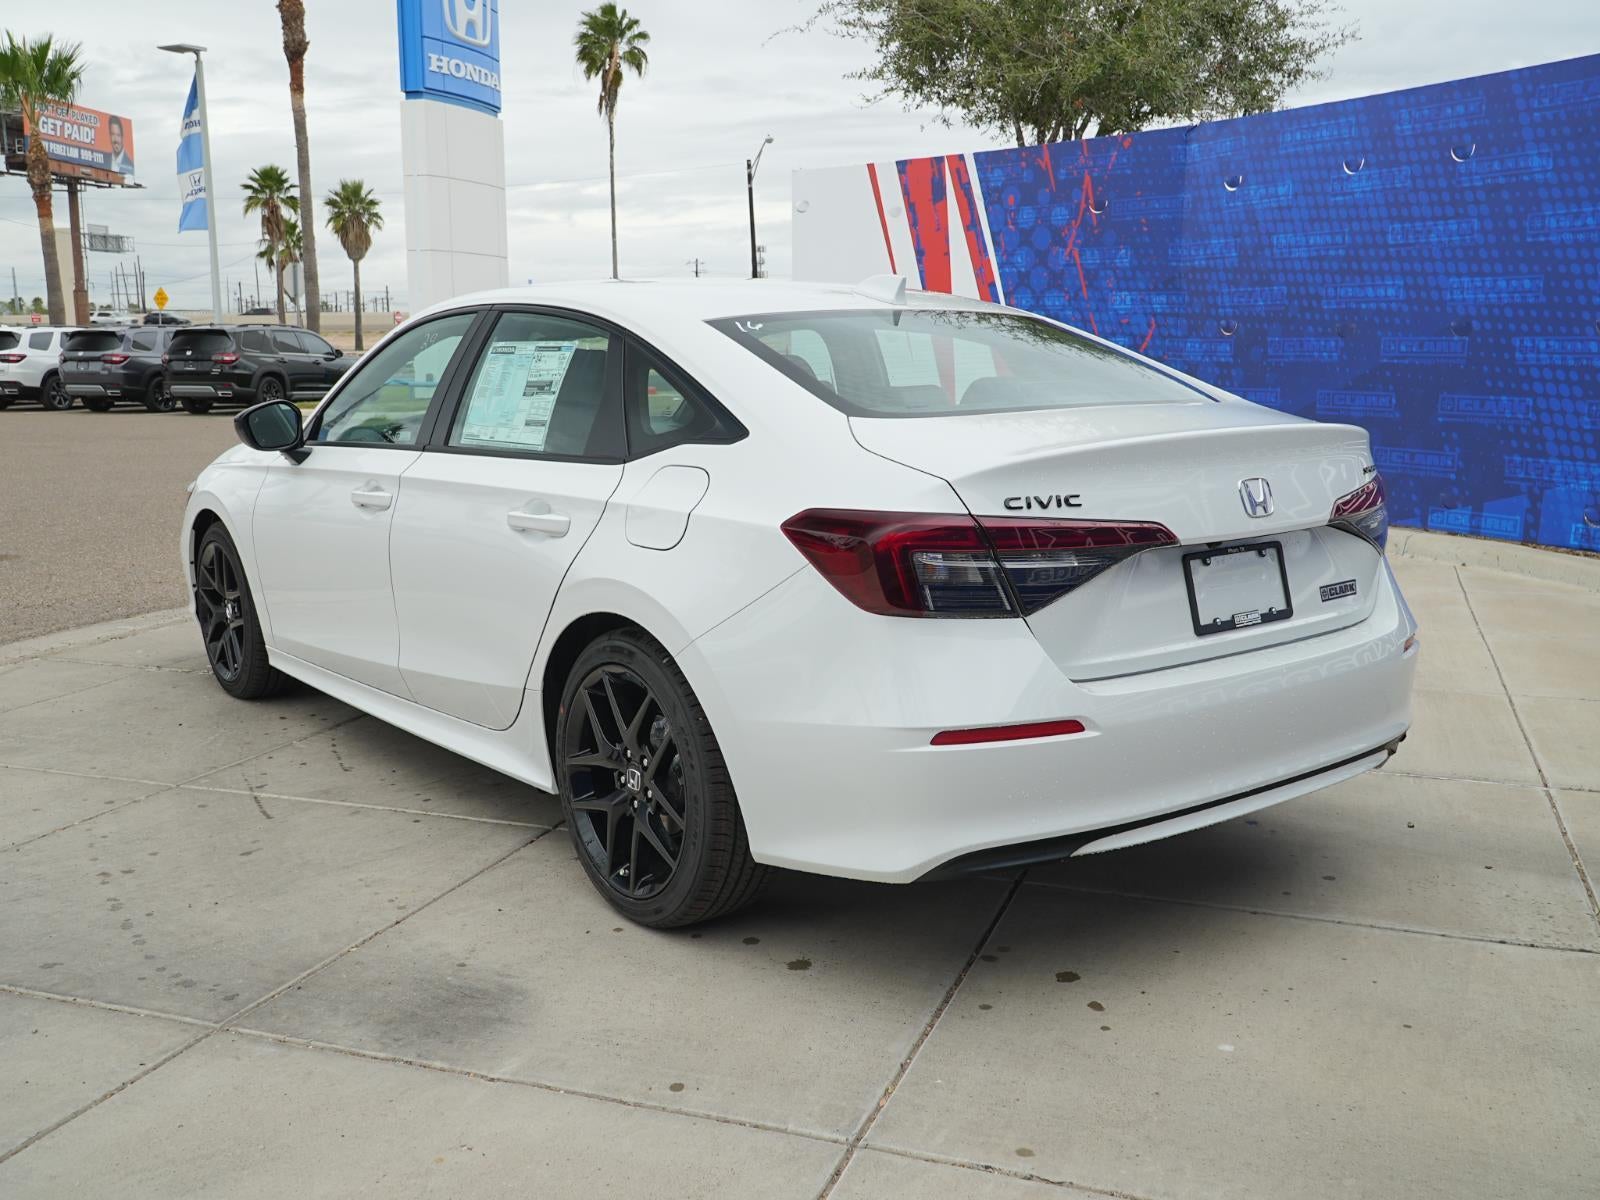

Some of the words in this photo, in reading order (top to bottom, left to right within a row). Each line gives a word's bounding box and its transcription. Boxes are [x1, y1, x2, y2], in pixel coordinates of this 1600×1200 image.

[428, 53, 501, 91] HONDA
[39, 116, 62, 137] GET
[64, 122, 95, 145] PAID!
[1004, 494, 1082, 510] CIVIC
[1329, 583, 1355, 597] CLARK
